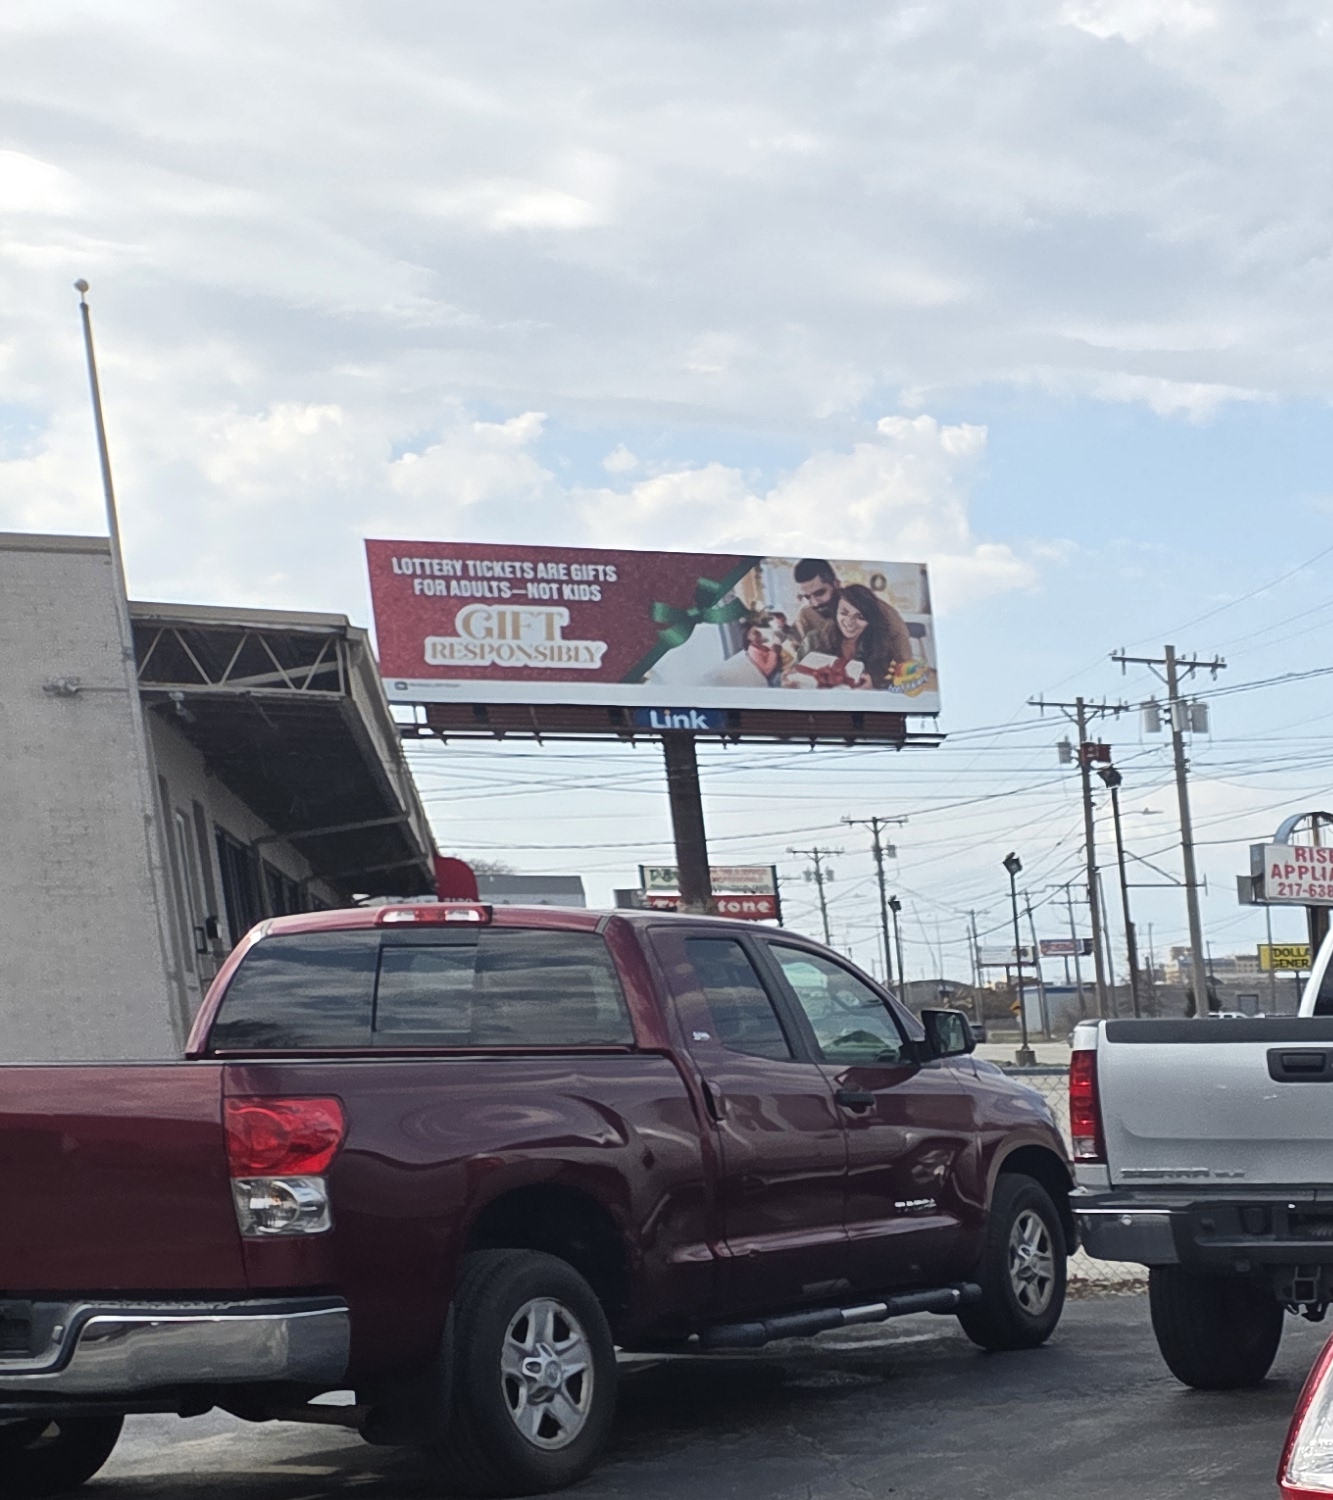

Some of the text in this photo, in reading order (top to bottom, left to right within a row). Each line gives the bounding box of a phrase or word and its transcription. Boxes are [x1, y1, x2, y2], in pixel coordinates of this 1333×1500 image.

[392, 556, 618, 583] LOTTERY TICKETS ARE GIFTS
[413, 578, 447, 597] FOR
[562, 583, 603, 602] KIDS
[461, 609, 565, 642] GIFT
[430, 641, 604, 664] RESPONSIBLY
[650, 708, 710, 731] Link
[1272, 947, 1311, 958] DOLLA
[1272, 958, 1310, 968] GENER
